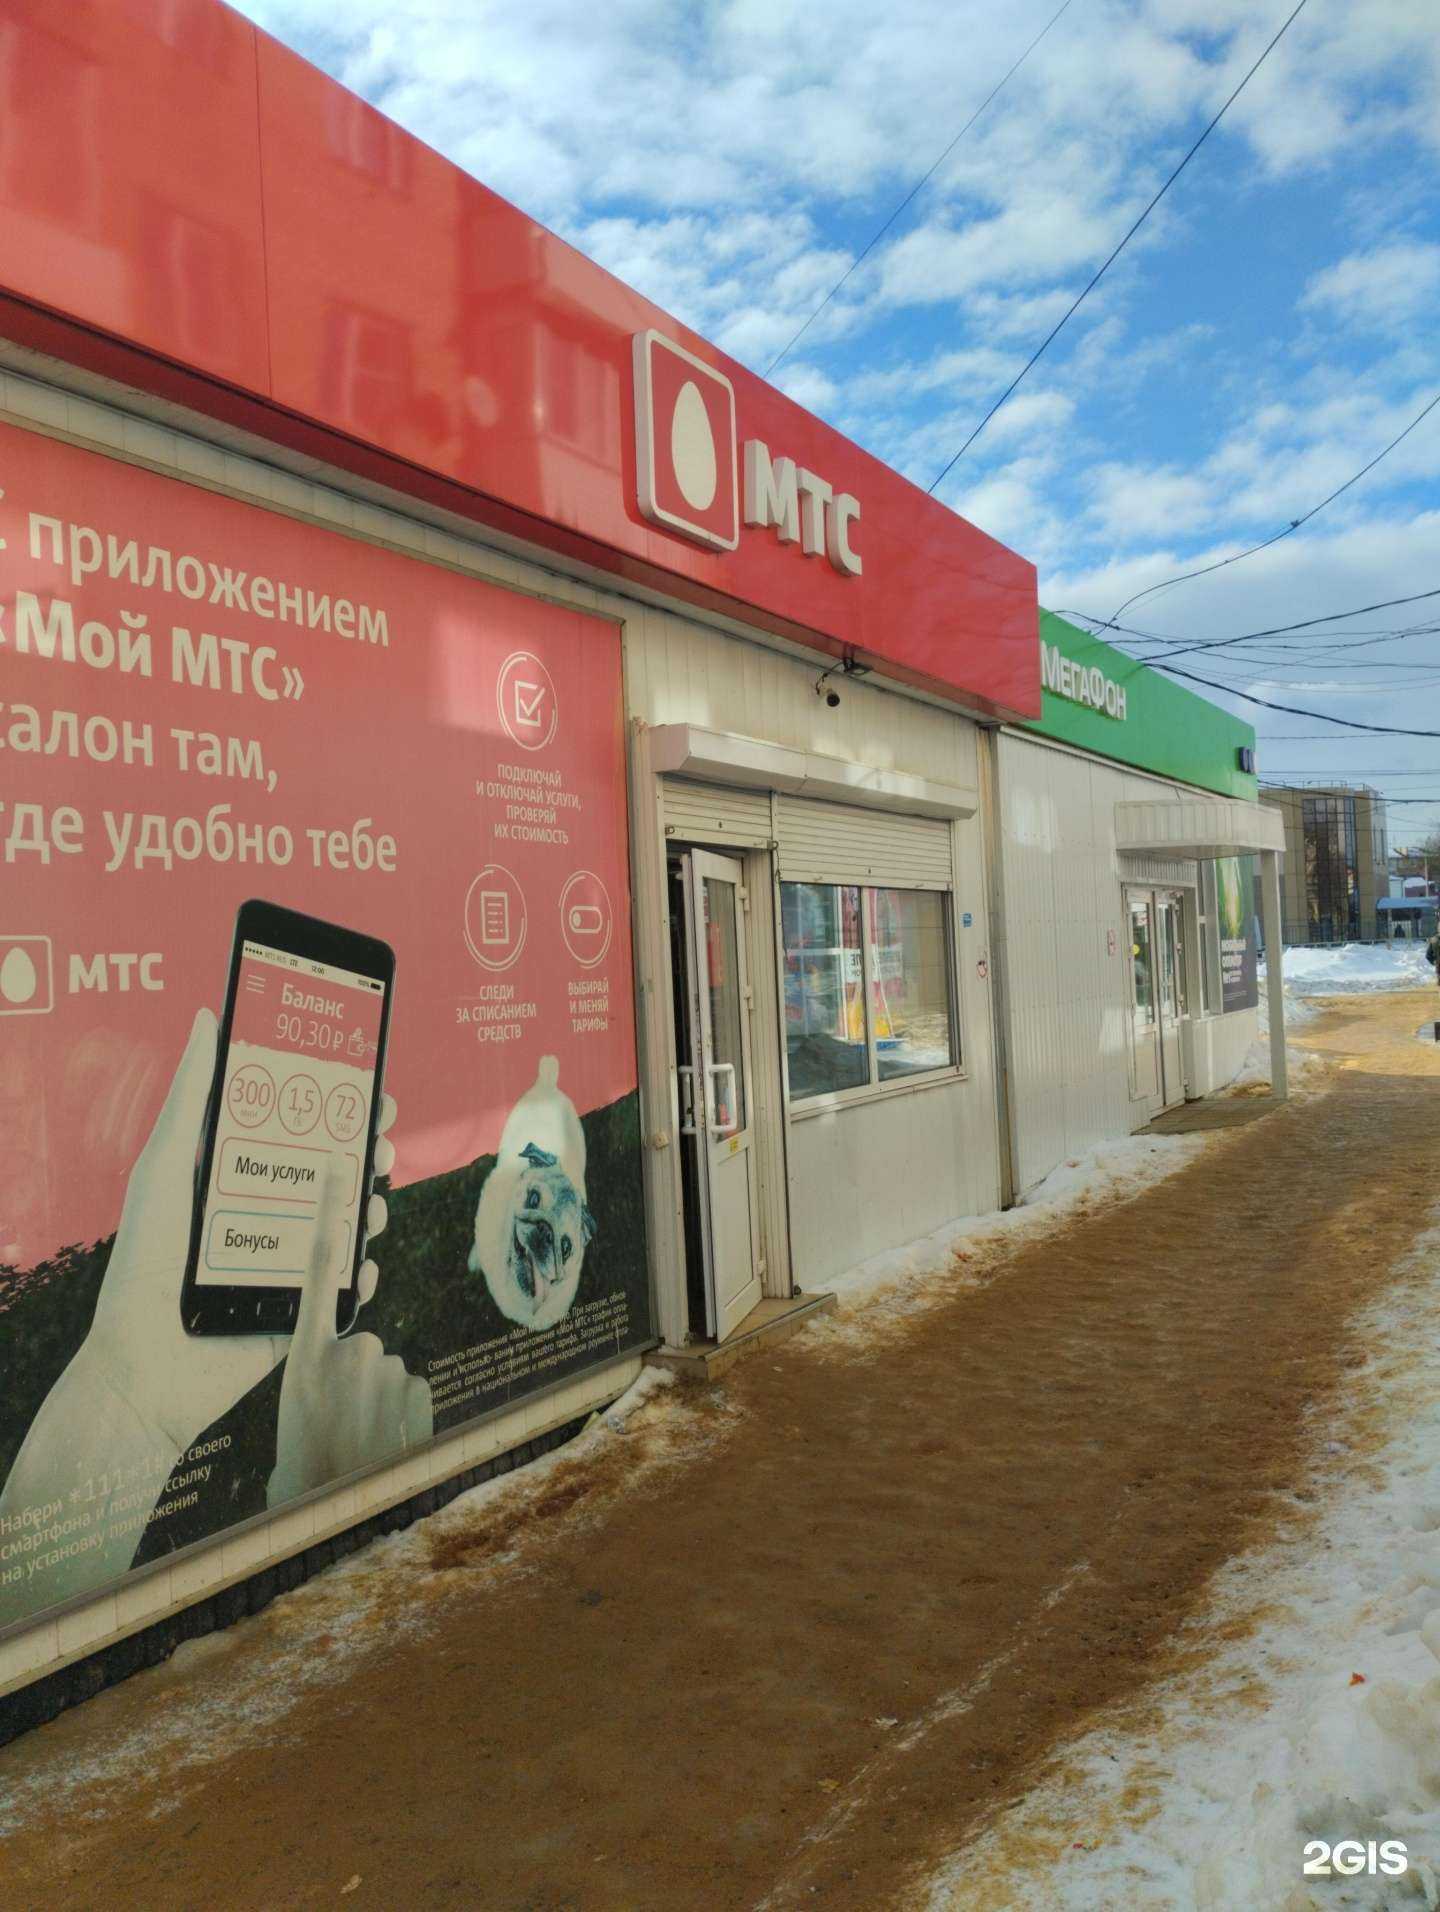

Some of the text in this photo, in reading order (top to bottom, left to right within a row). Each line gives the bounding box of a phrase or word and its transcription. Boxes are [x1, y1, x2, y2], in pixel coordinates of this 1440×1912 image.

[744, 439, 862, 576] МТС
[29, 512, 389, 647] приложением
[172, 627, 305, 701] МТС»
[170, 728, 278, 793] там,
[486, 782, 544, 804] ОТКЛЮЧАЙ
[505, 804, 557, 824] ПРОВЕРЯЙ
[103, 803, 293, 872] удобно
[306, 818, 397, 872] тебе
[494, 823, 569, 845] ИХ СТОИМОСТЬ
[281, 982, 345, 1019] Баланс
[480, 984, 514, 1002] СЛЕДИ
[567, 977, 609, 995] ВЫБИРАЙ
[456, 1003, 537, 1023] ЗА СПИСАНИЕМ
[571, 1018, 608, 1033] ТАРИФЫ
[477, 1024, 522, 1042] СРЕДСТВ
[232, 1077, 271, 1108] 300
[288, 1087, 314, 1116] 1,5
[336, 1094, 356, 1120] 72
[235, 1156, 315, 1185] Мои услуги
[224, 1228, 279, 1254] Бонусы
[0, 1497, 62, 1536] Набери
[188, 1433, 232, 1462] своего
[0, 1512, 91, 1562] смартфона
[165, 1463, 212, 1493] ссылку
[1, 1490, 199, 1586] на установку приложения
